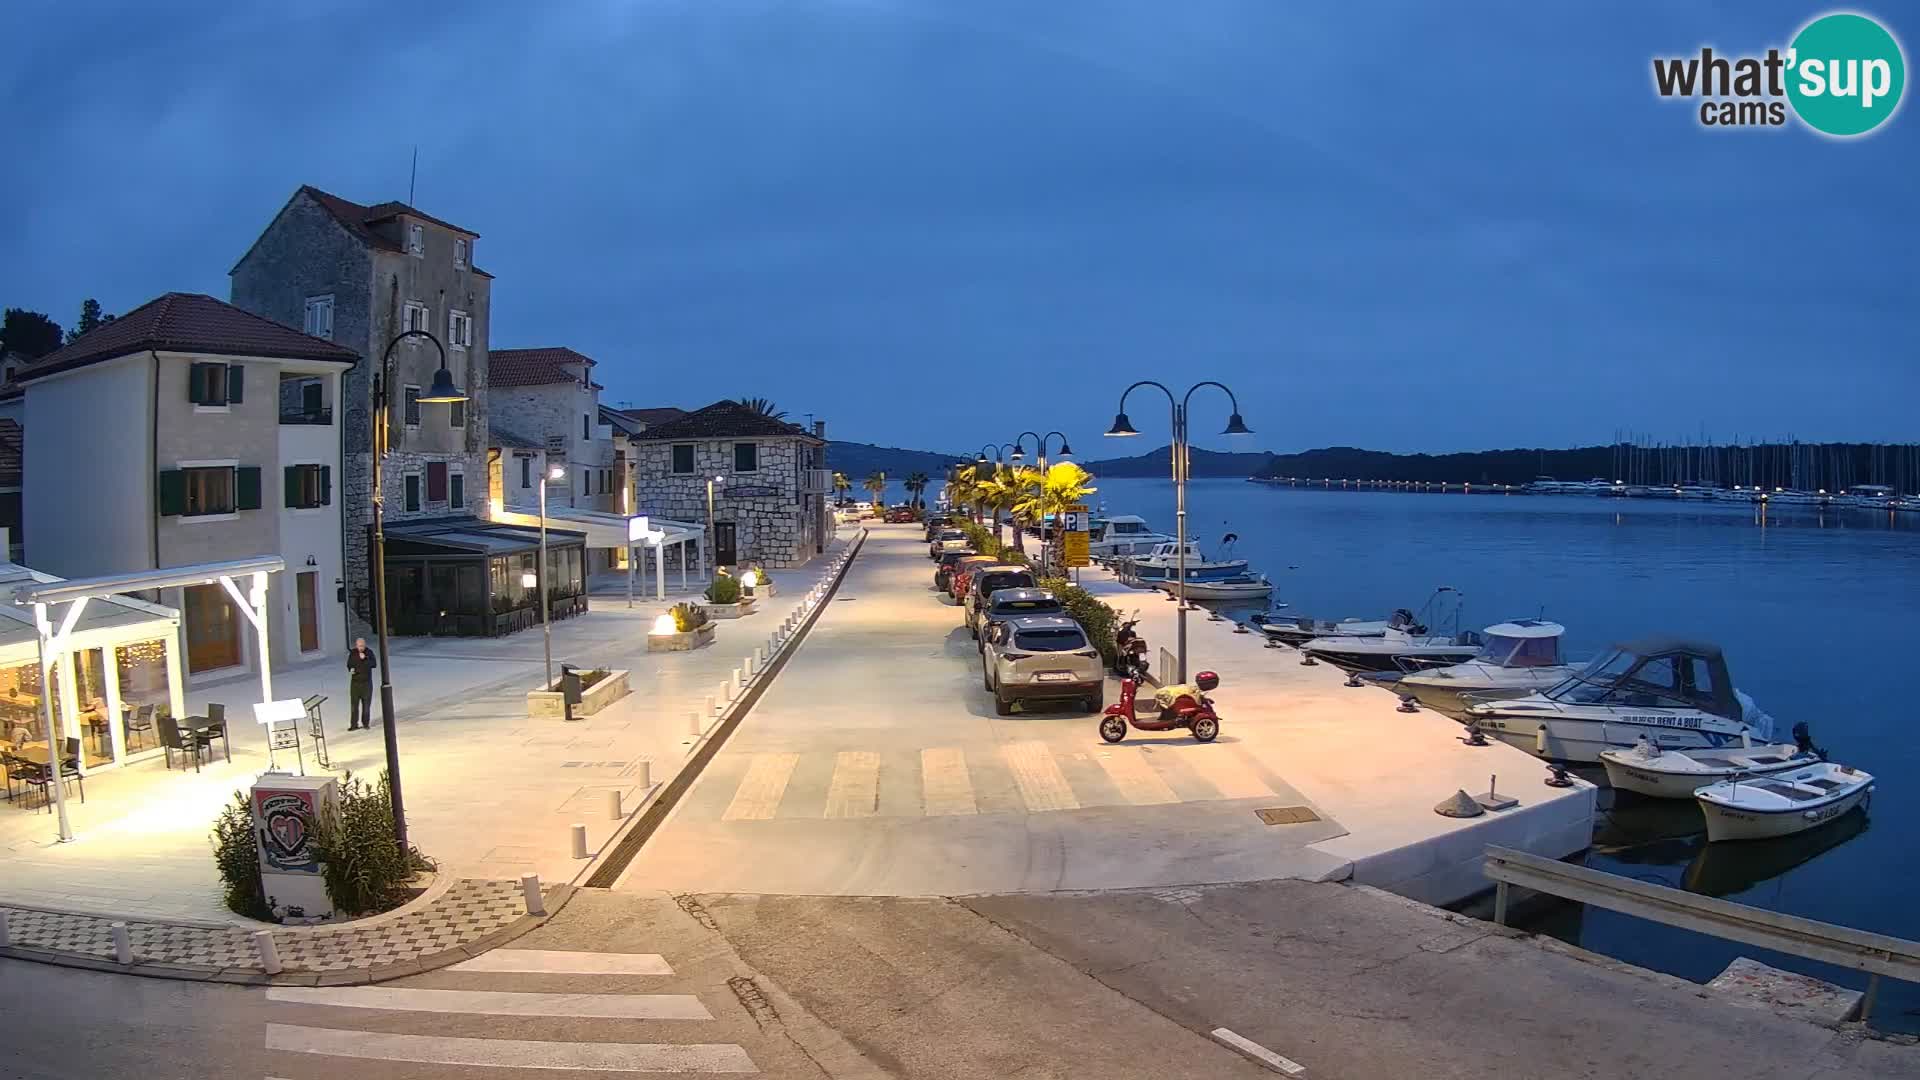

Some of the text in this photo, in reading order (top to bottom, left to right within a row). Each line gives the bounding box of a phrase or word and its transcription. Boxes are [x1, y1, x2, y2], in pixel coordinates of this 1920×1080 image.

[1066, 514, 1076, 530] P
[1656, 716, 1676, 726] RENT
[1684, 717, 1702, 728] BOAT
